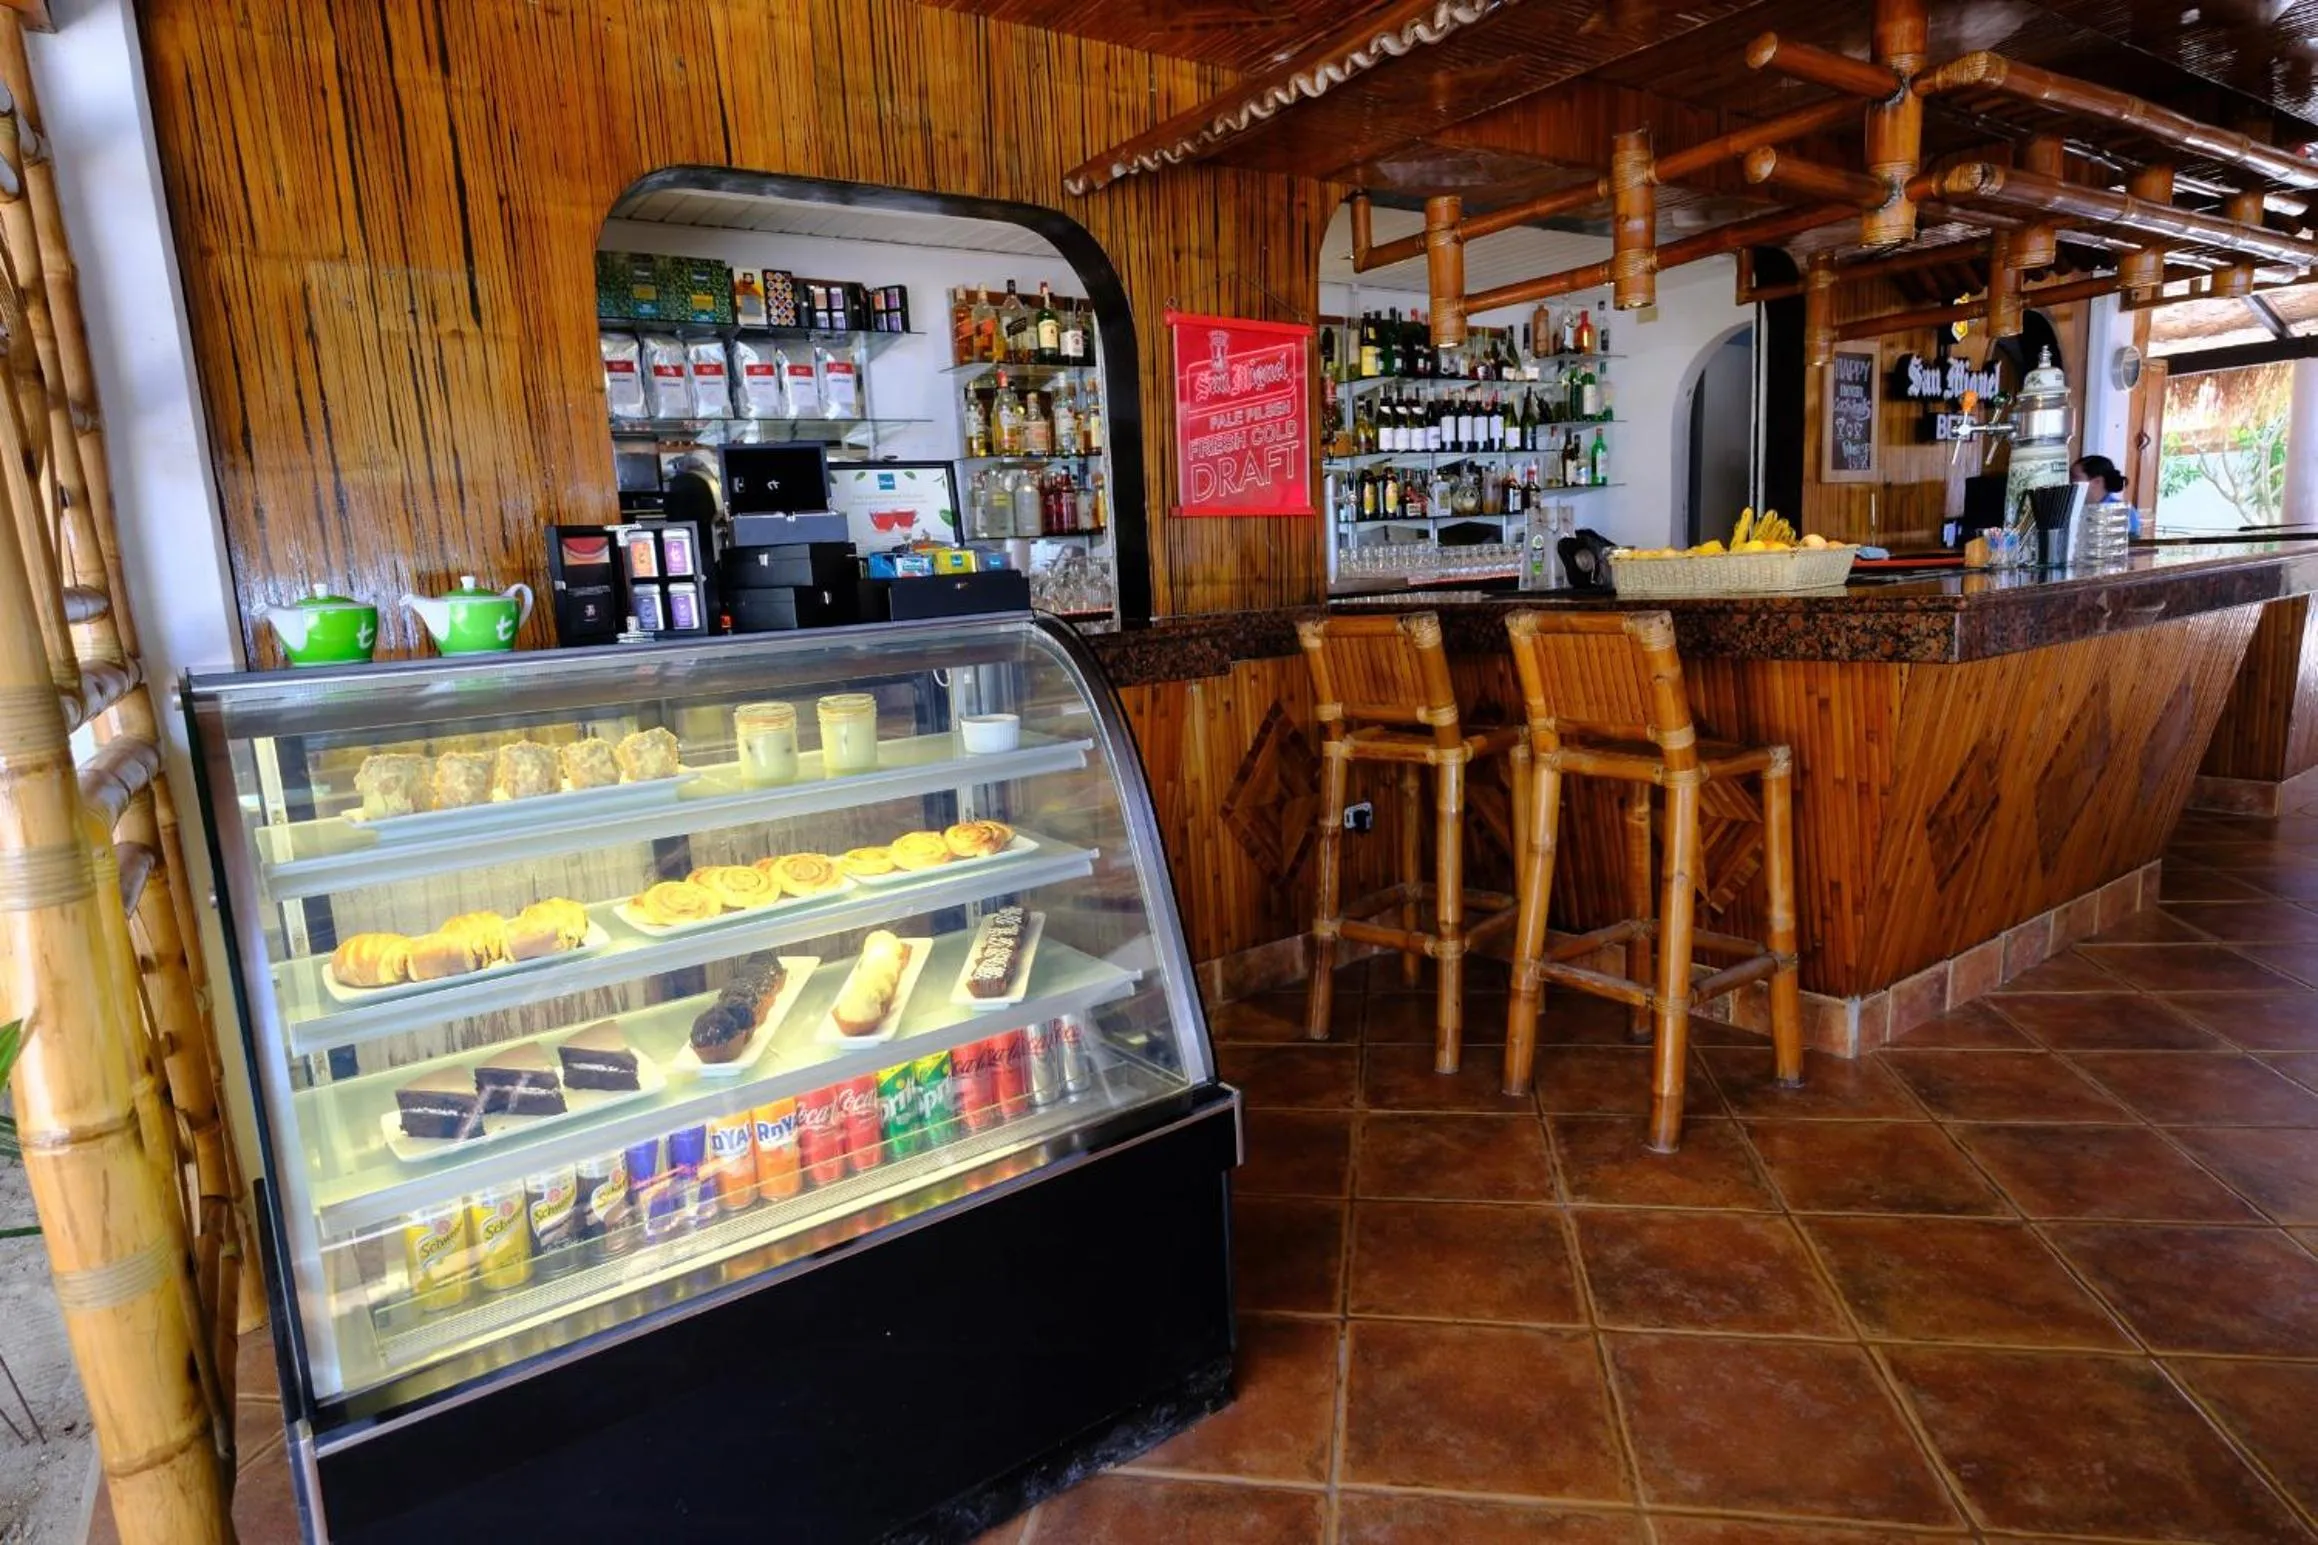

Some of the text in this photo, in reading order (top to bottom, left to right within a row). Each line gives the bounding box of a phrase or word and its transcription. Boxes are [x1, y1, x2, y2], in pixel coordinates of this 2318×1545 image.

[1195, 369, 1231, 402] San
[1835, 357, 1871, 382] HAPPY
[1907, 354, 1942, 397] San
[1209, 399, 1291, 430] PALE PILSEN
[1188, 420, 1298, 461] FRESH COLD
[1191, 440, 1300, 503] DRAFT
